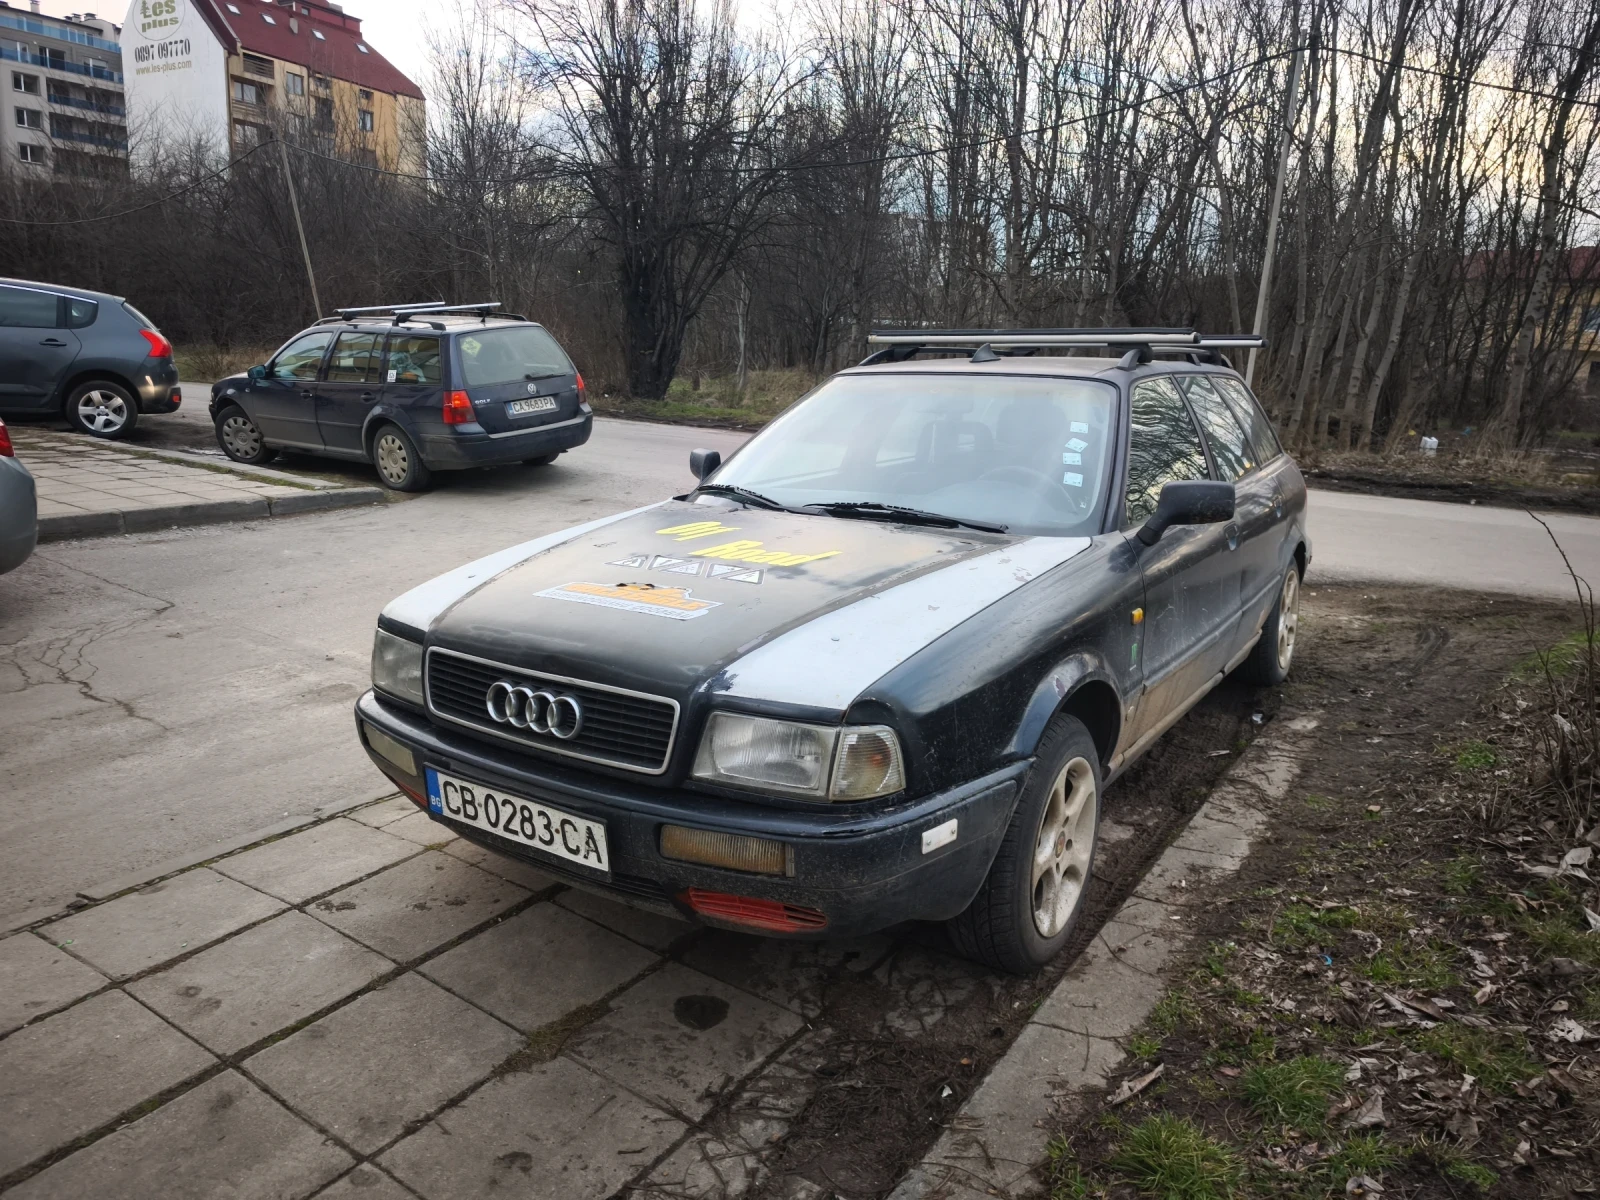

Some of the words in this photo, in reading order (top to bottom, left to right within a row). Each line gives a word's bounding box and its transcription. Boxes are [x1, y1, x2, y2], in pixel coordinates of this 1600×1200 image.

[142, 17, 179, 33] plus
[134, 44, 154, 63] 0897
[158, 38, 191, 59] 097770
[136, 60, 192, 76] www.les-plus.com
[688, 540, 843, 567] Road
[431, 795, 442, 807] BG
